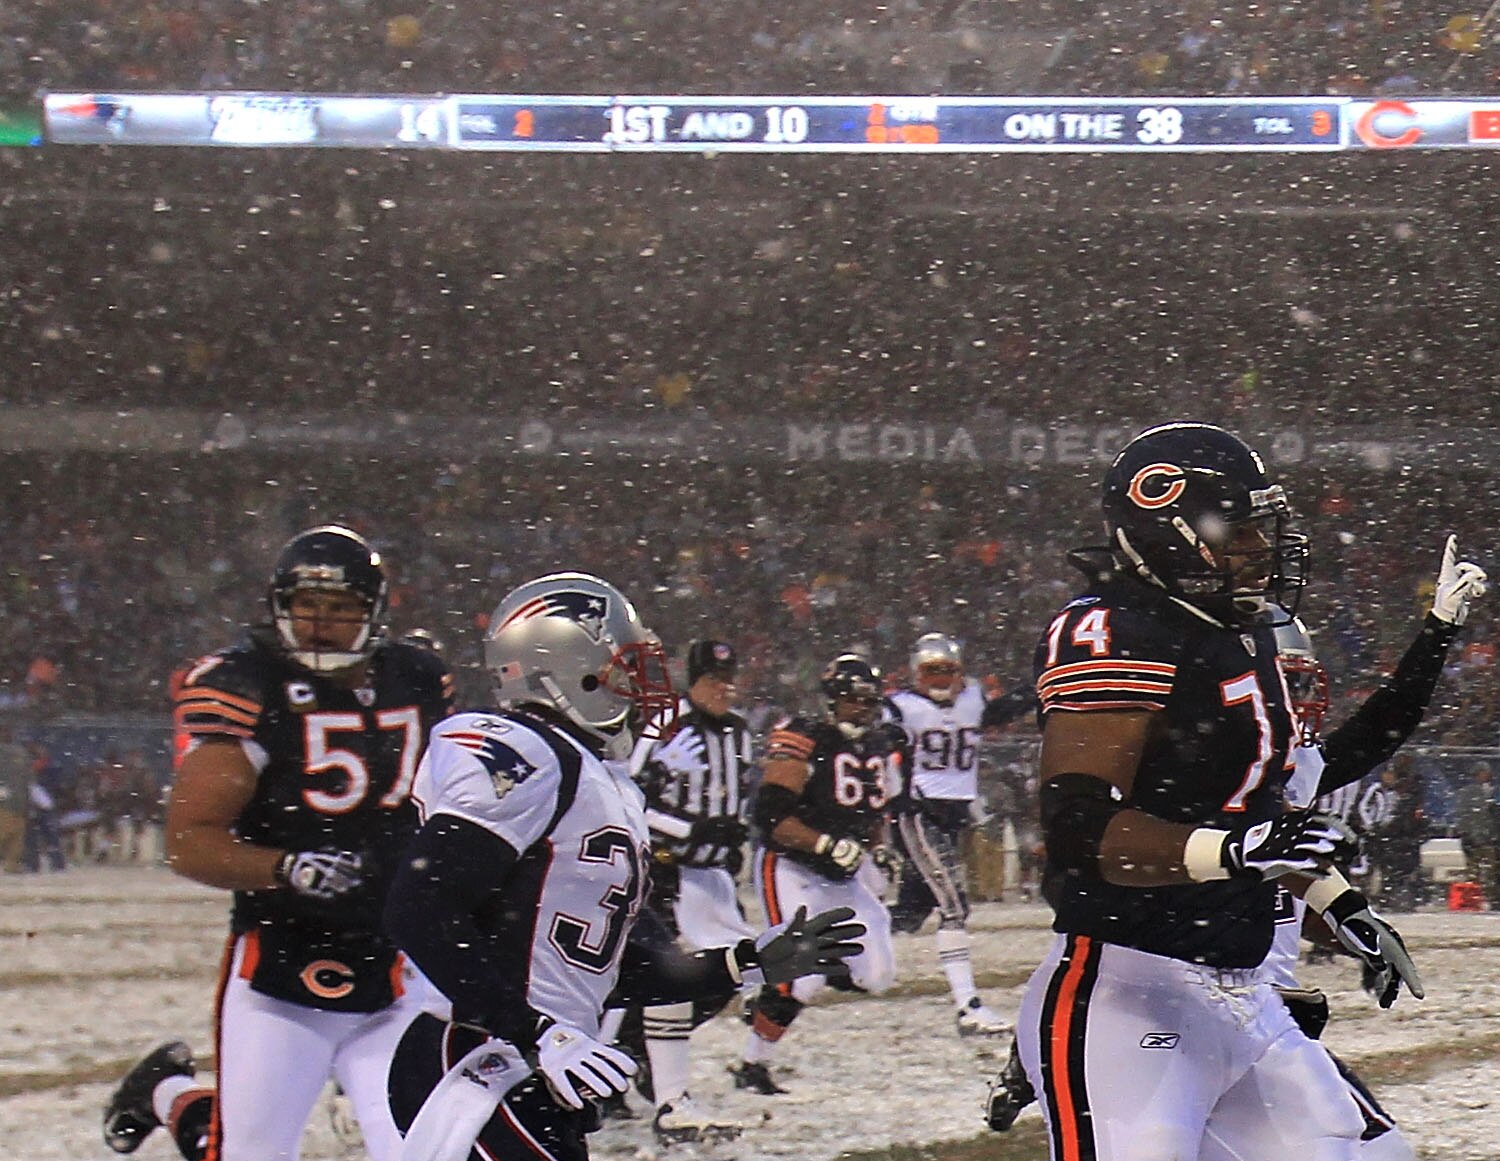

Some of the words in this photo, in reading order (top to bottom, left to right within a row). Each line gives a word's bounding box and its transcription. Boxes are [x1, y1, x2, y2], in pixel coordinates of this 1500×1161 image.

[397, 104, 441, 142] 14
[603, 106, 671, 142] 1ST
[681, 111, 754, 139] AND
[764, 107, 808, 142] 10
[1003, 113, 1056, 139] ON
[1060, 113, 1125, 139] THE
[1136, 107, 1183, 143] 38
[785, 423, 980, 462] MEDIA
[1009, 423, 1133, 462] DEC
[1044, 607, 1111, 668] 74
[302, 705, 421, 814] 57
[921, 727, 980, 771] 96
[834, 752, 887, 808] 63
[548, 824, 655, 975] 3
